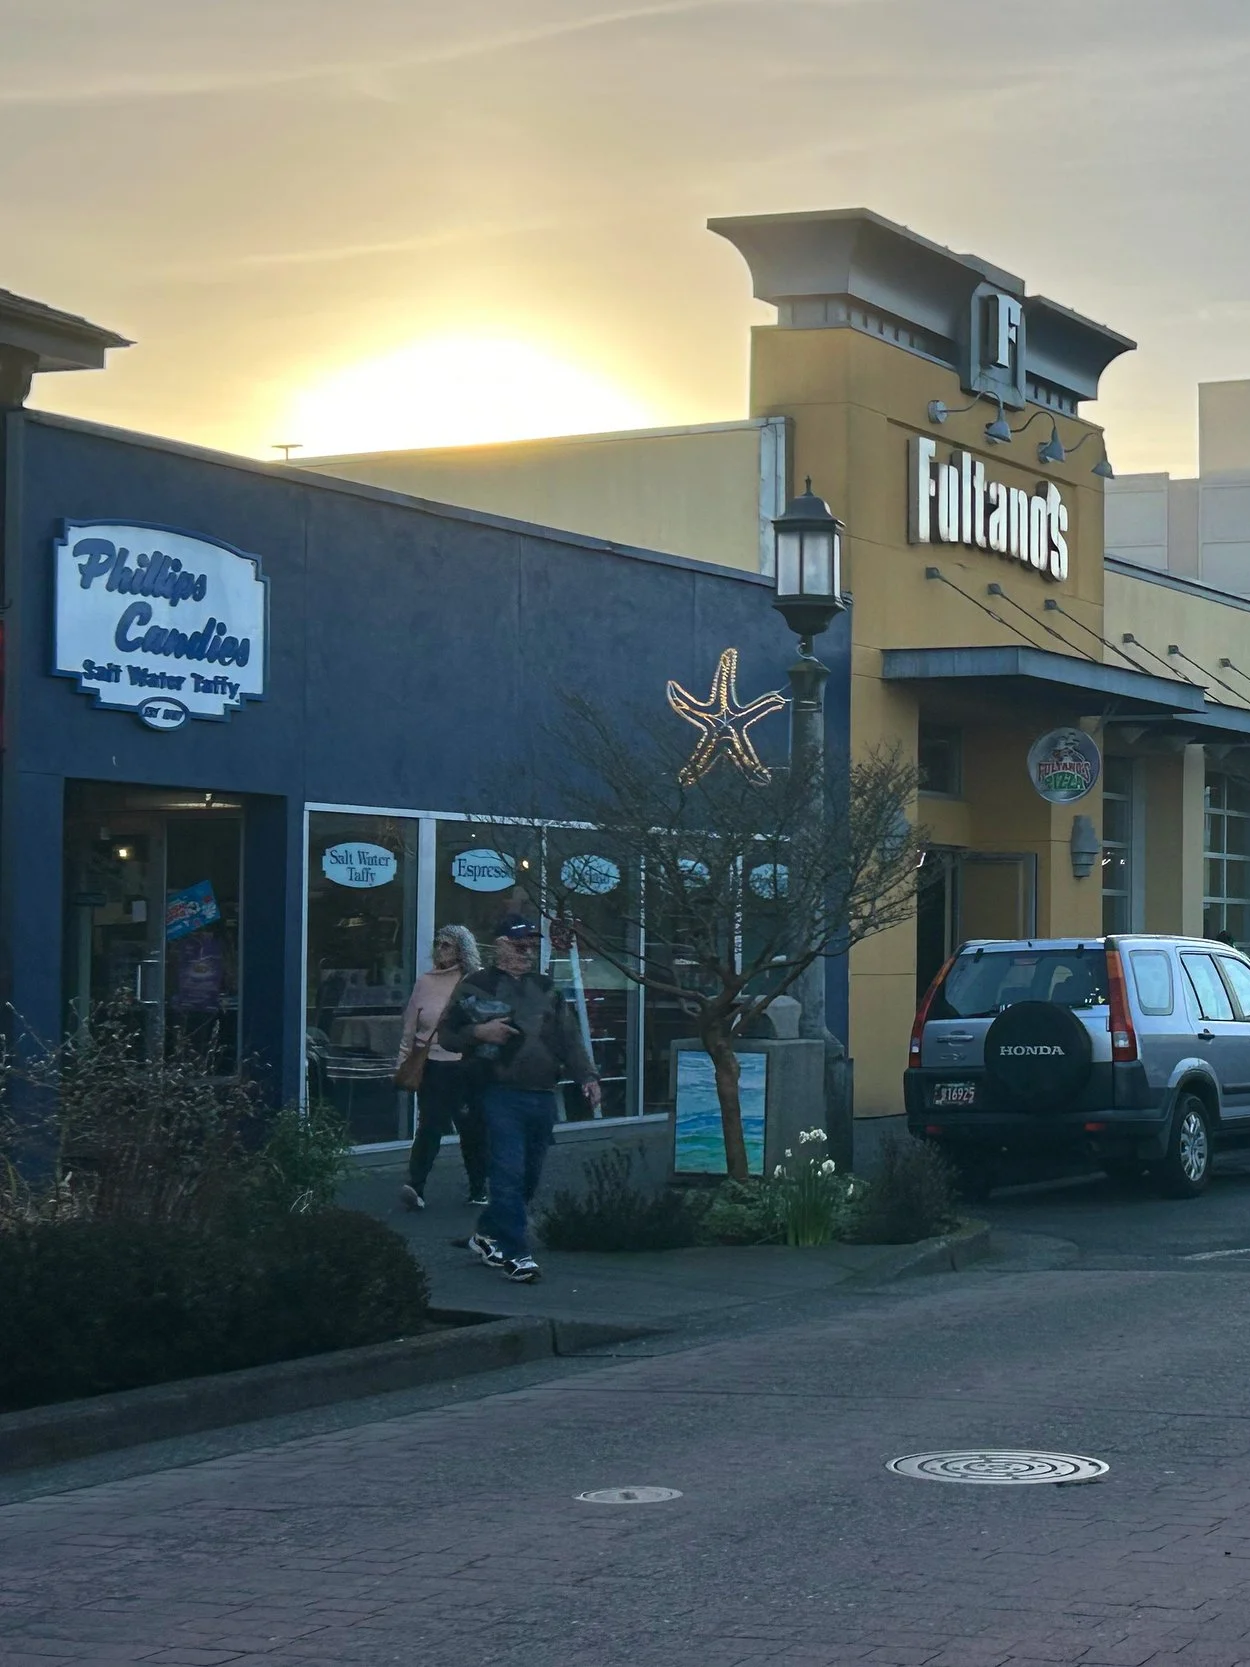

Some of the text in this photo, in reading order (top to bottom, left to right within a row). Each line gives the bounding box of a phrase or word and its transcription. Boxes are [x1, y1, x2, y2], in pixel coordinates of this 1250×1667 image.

[988, 294, 1023, 369] F
[911, 437, 1069, 581] Fultano's
[72, 537, 208, 607] Phillips
[115, 601, 251, 667] Candies
[82, 659, 241, 699] Salt Water Taffy
[330, 849, 353, 865] Salt
[999, 1046, 1065, 1056] HONDA
